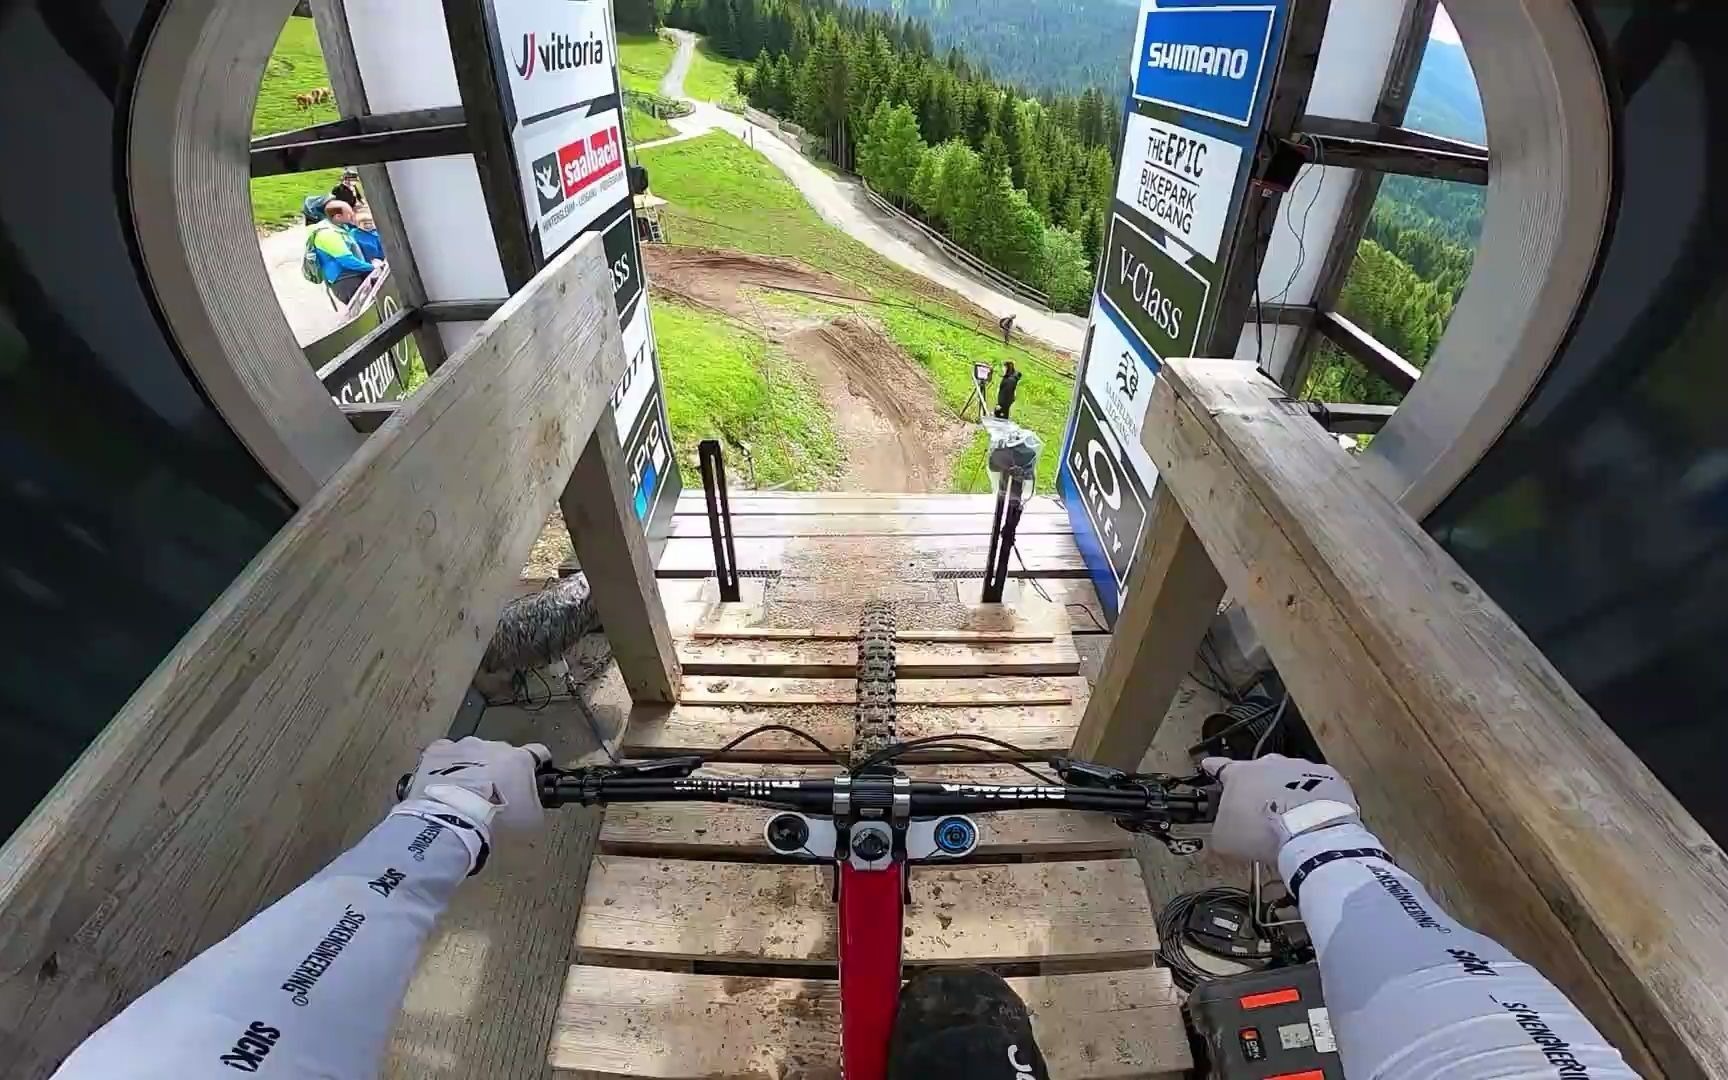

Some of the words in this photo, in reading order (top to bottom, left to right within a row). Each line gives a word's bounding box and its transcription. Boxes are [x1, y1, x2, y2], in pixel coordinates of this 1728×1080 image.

[538, 31, 603, 72] vittoria
[1147, 42, 1249, 80] SHIMANO
[564, 127, 618, 188] saalbach
[1147, 136, 1166, 163] THE
[1164, 132, 1207, 178] EPIC
[1136, 186, 1193, 236] LEOGANG
[1140, 167, 1197, 213] BIKEPARK
[1119, 245, 1184, 340] V-Class
[611, 339, 646, 411] COTT
[1074, 451, 1122, 554] OAKLEY
[219, 1021, 281, 1073] SICK!
